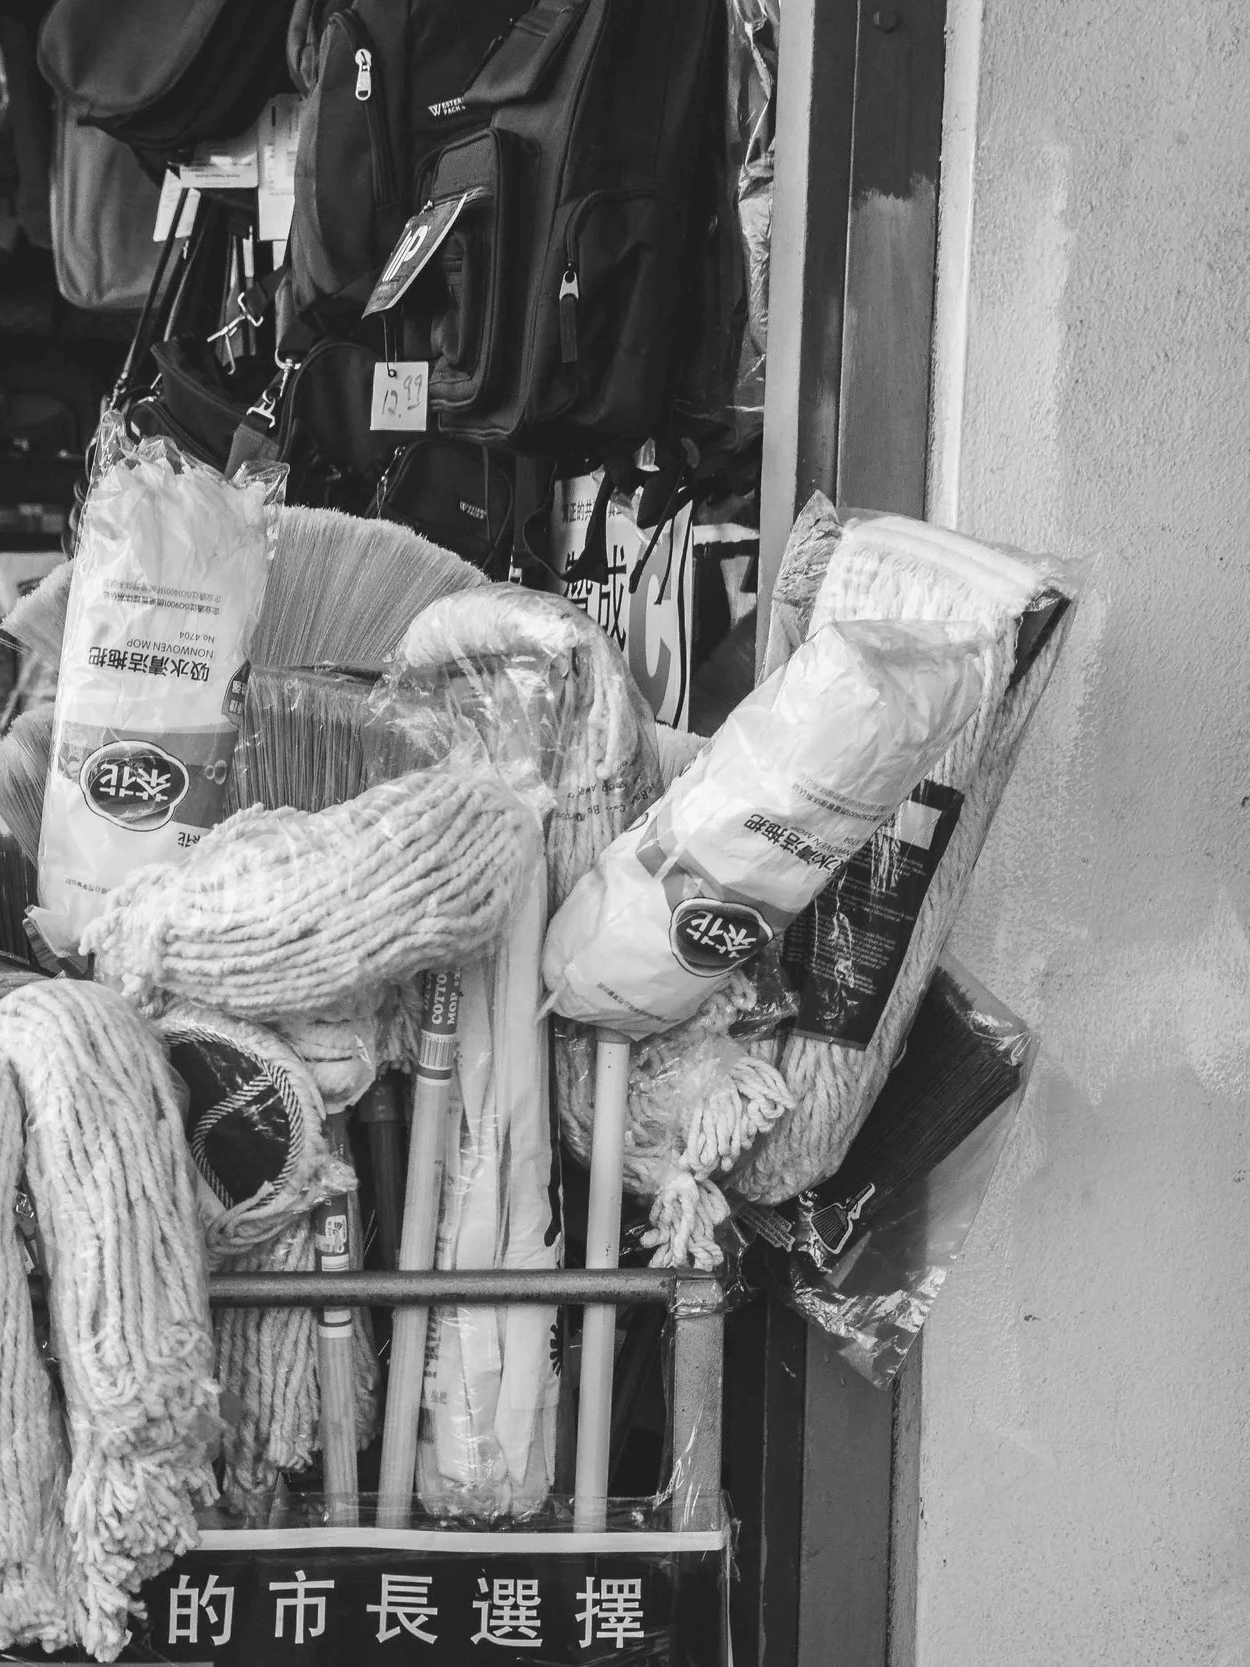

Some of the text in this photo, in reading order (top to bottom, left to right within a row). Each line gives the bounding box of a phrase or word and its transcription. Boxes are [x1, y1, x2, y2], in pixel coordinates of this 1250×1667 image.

[88, 645, 210, 682] 吸水清洁拖把
[126, 637, 213, 659] NONWOVEN MOP
[98, 763, 170, 802] 茶花
[685, 912, 756, 960] 茶花
[431, 973, 447, 1024] COTTO
[126, 1569, 645, 1649] 的市長選擇
